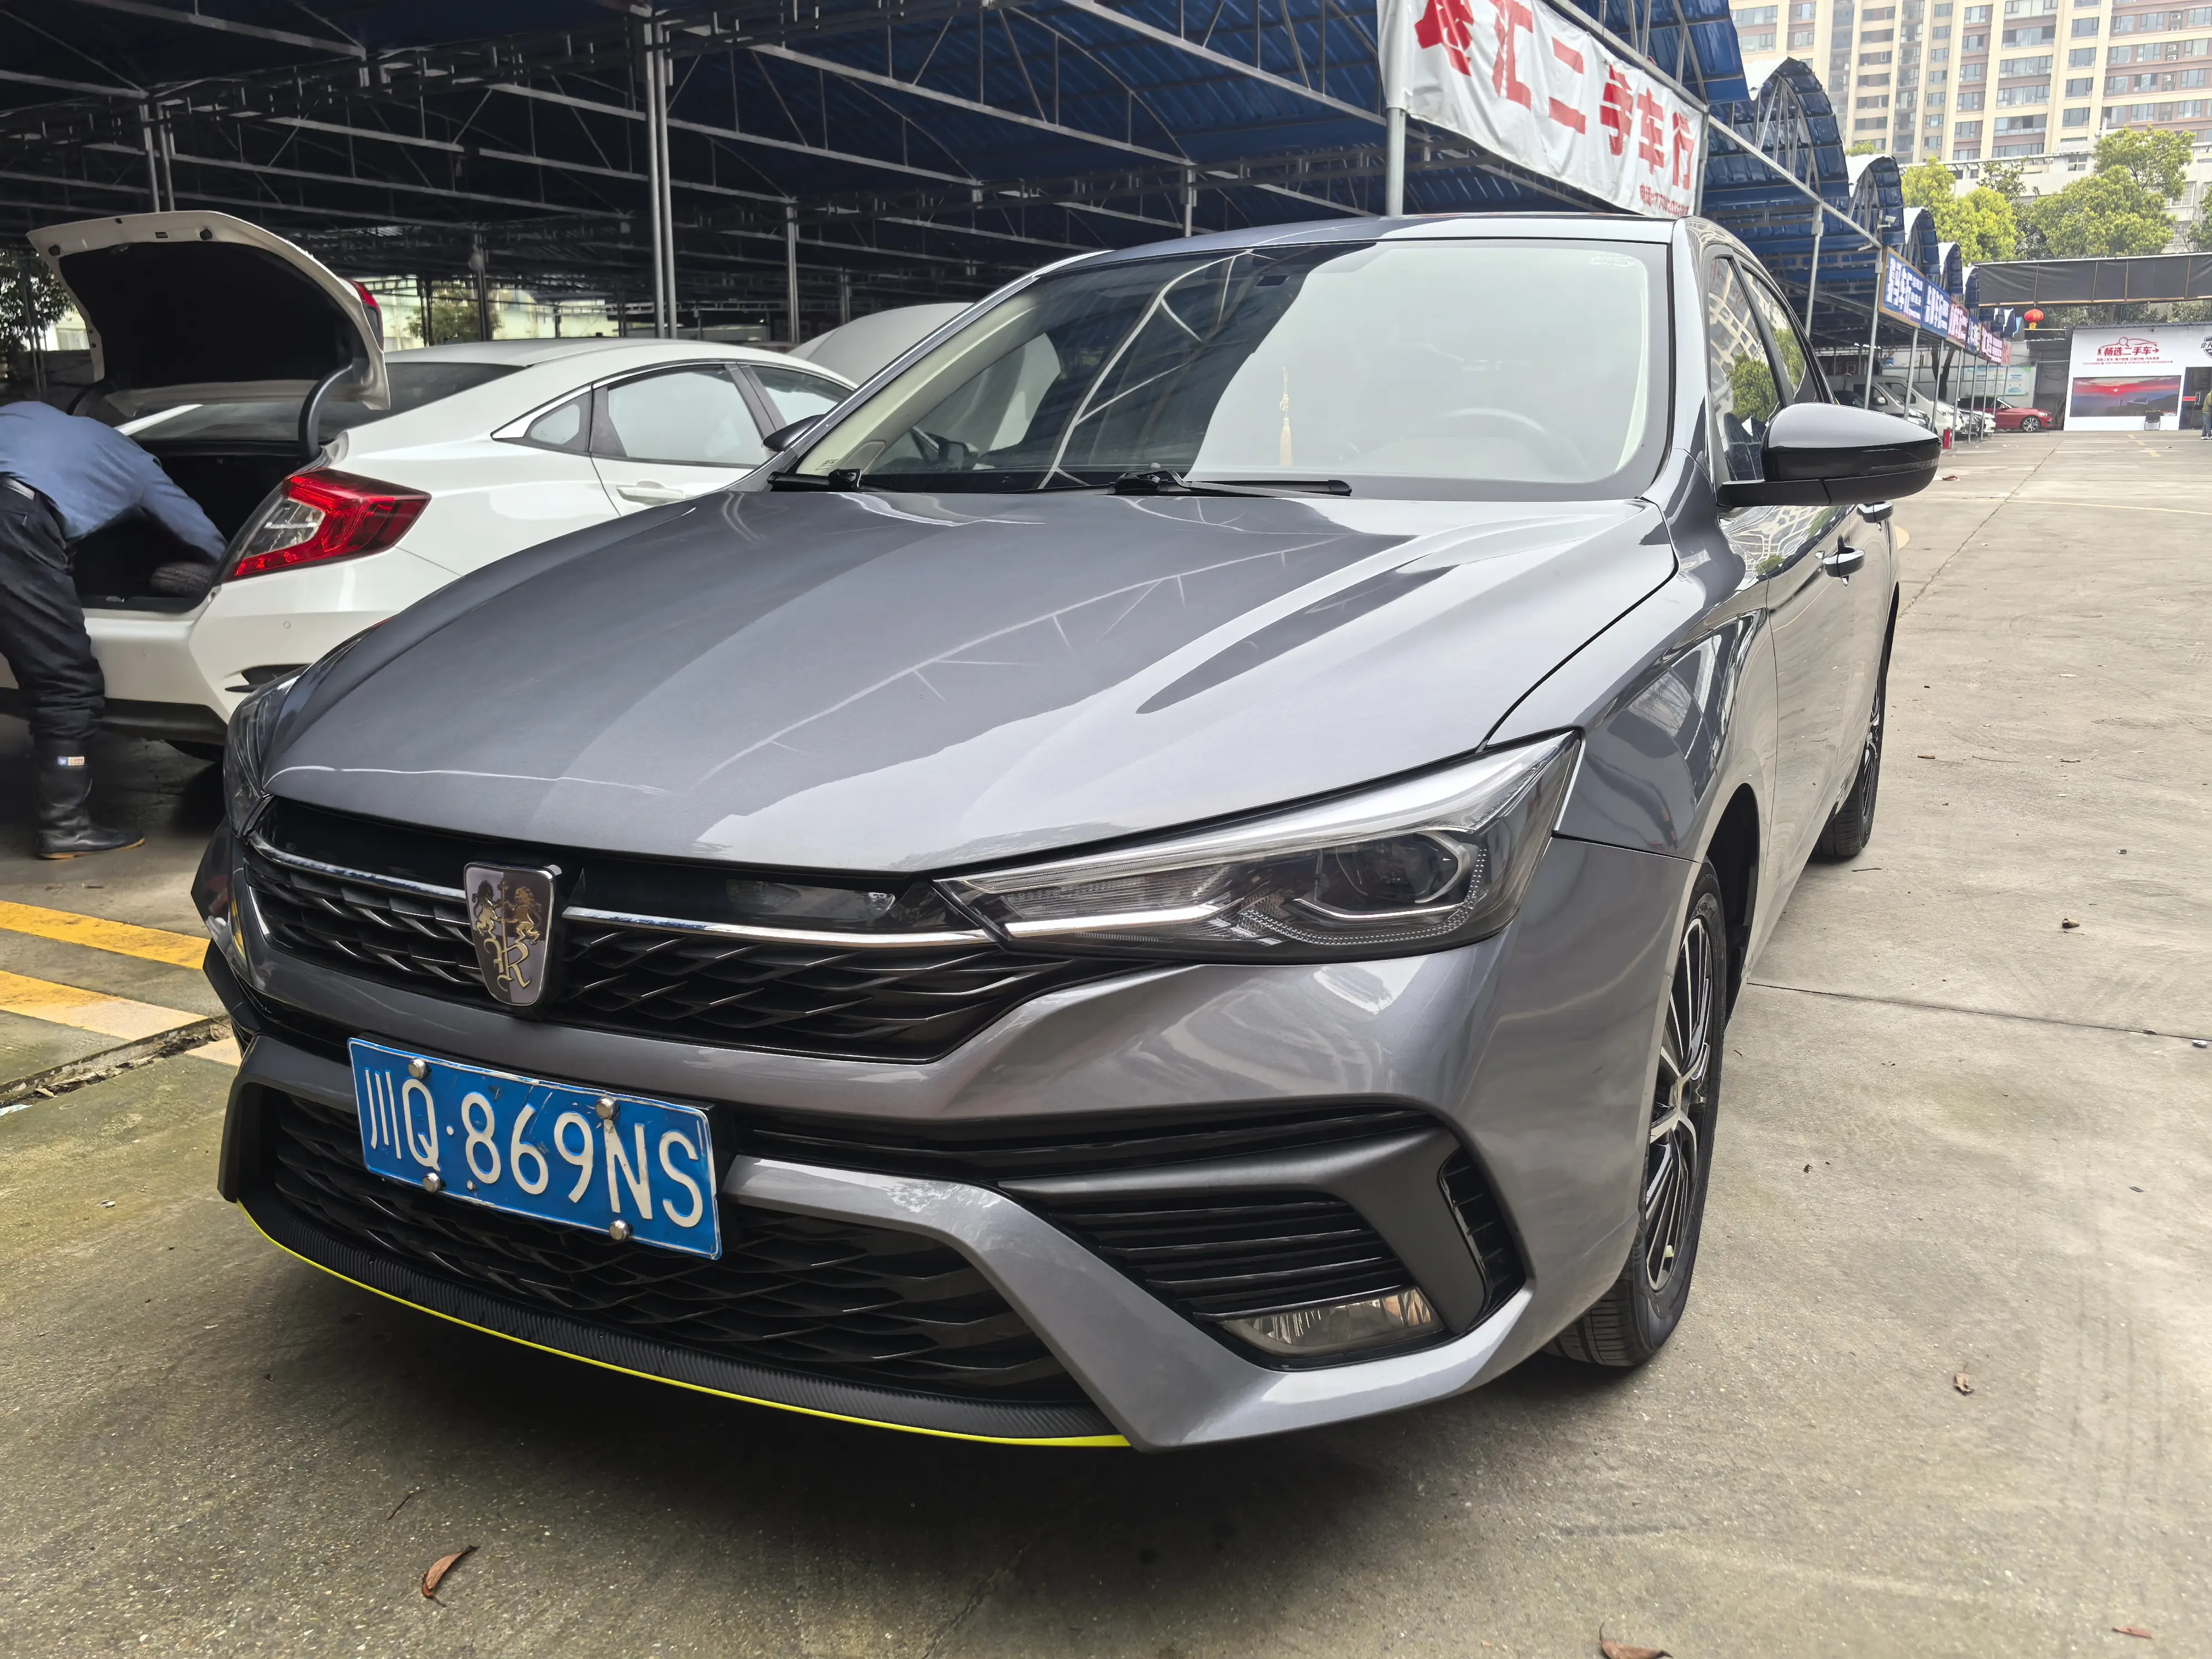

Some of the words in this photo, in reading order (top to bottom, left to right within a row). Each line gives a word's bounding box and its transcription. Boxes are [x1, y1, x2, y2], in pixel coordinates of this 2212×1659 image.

[2104, 346, 2152, 357] 畅选二手车
